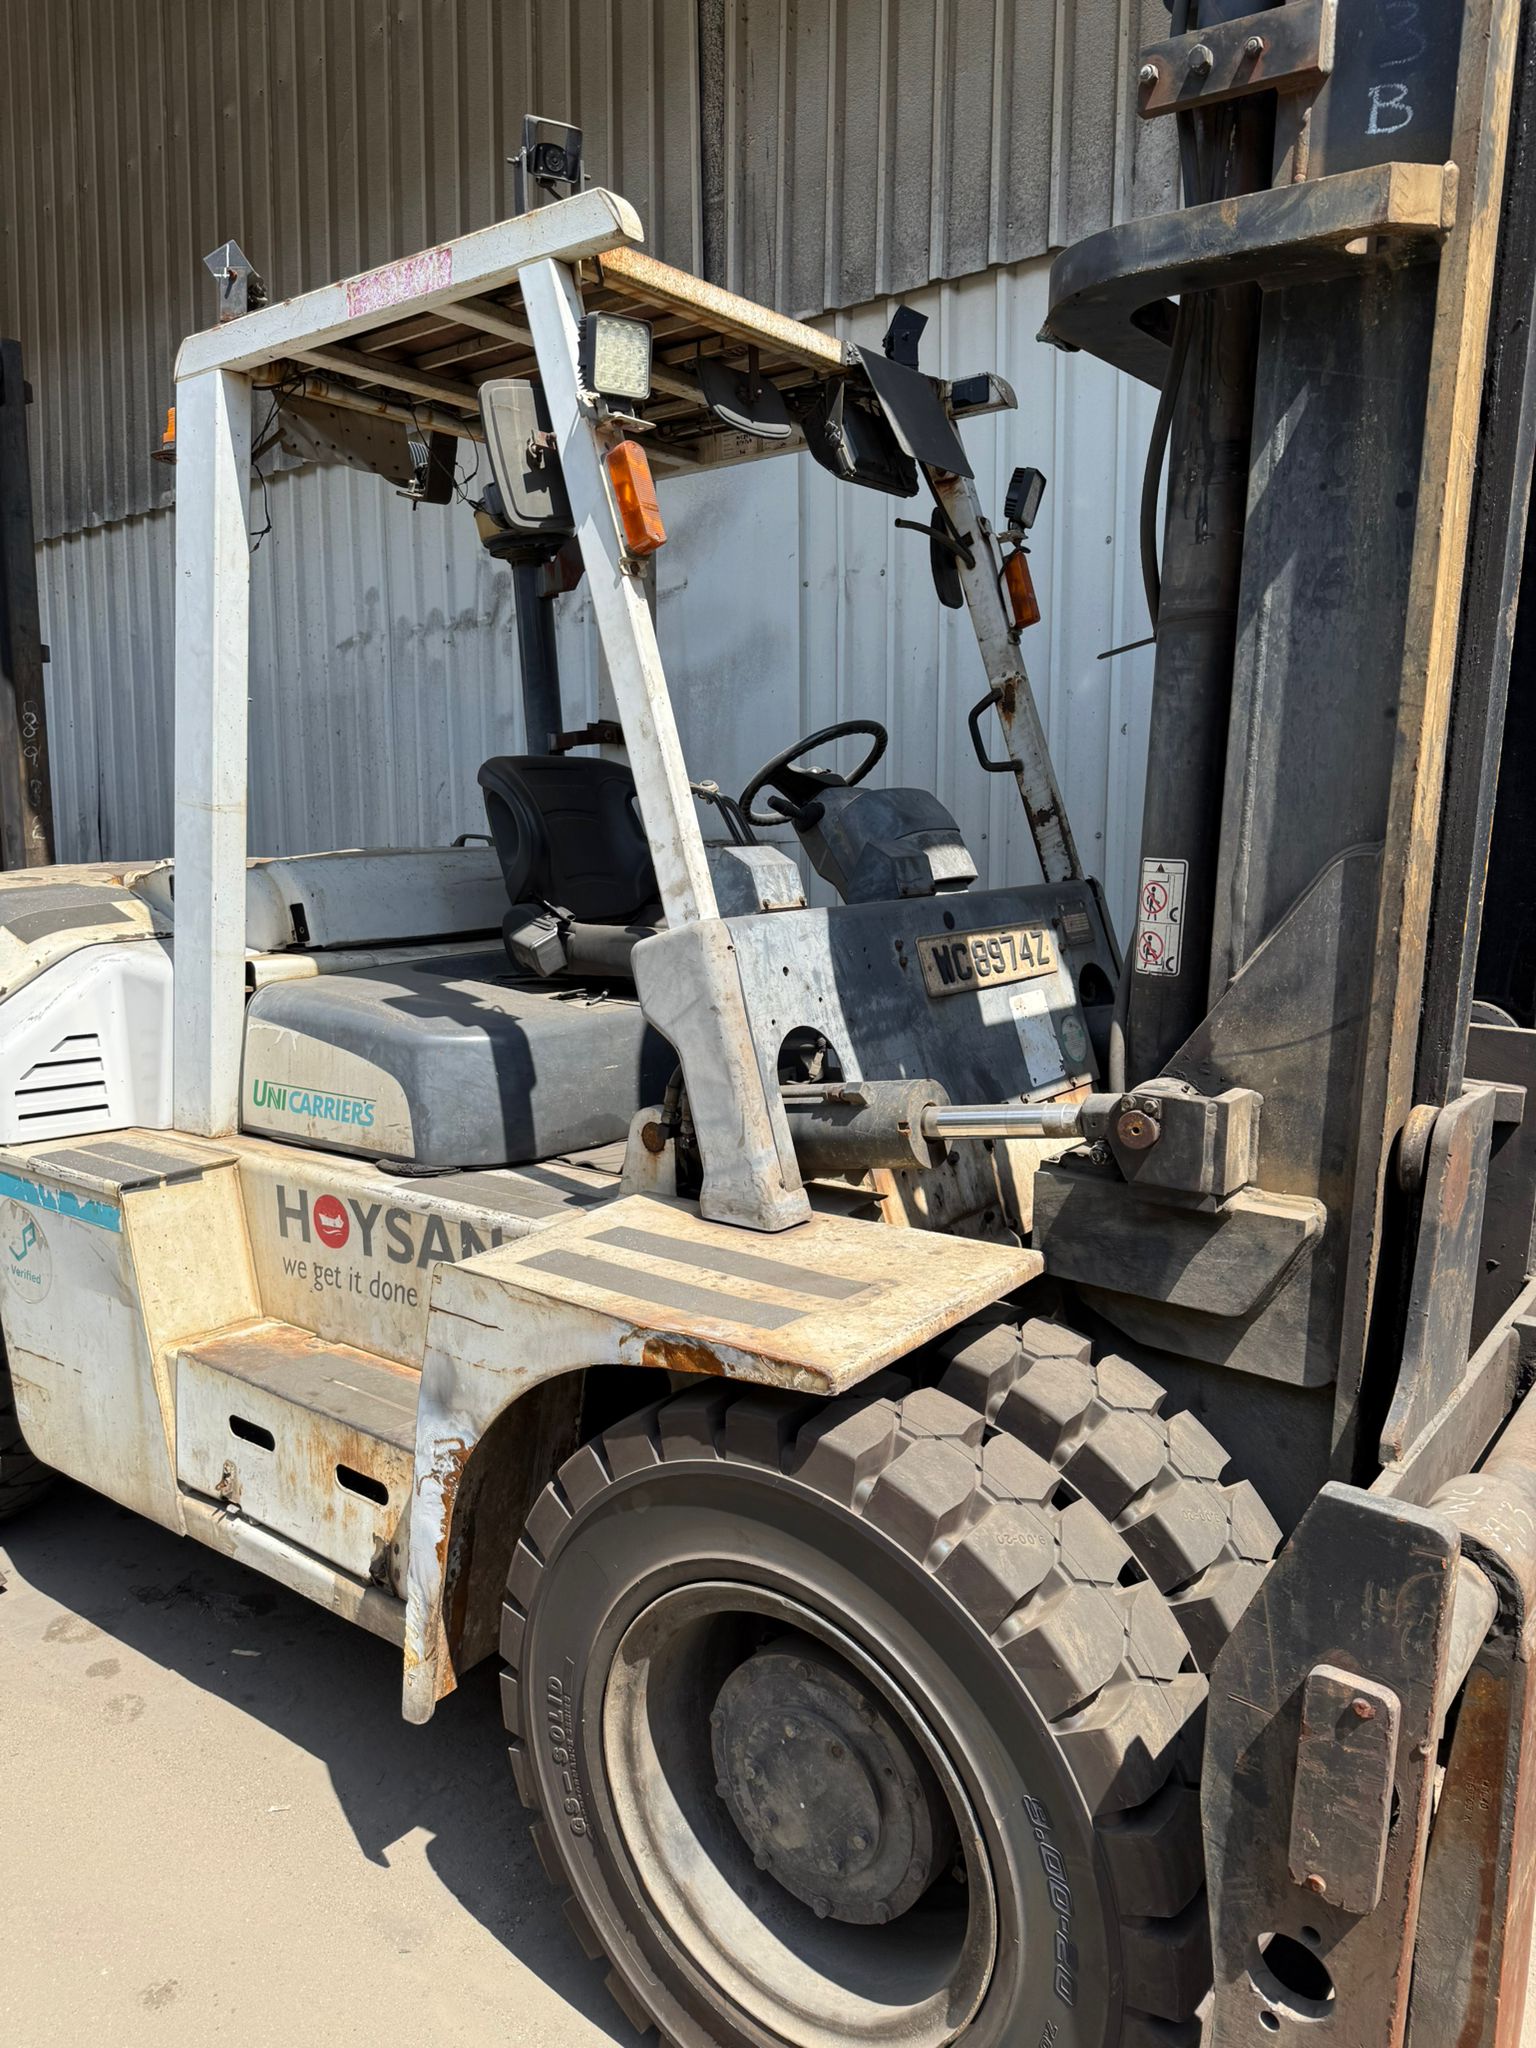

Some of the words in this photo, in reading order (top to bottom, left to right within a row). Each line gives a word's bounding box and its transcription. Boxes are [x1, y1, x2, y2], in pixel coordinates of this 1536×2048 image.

[1364, 82, 1414, 135] B
[931, 930, 1050, 985] WC8974Z
[253, 1079, 376, 1127] UNICARRIERS
[10, 1263, 42, 1286] Verified
[283, 1257, 308, 1279] we
[313, 1262, 342, 1292] get
[348, 1267, 363, 1295] it
[369, 1270, 418, 1308] done
[997, 1533, 1047, 1546] 9.00-20
[1022, 1793, 1078, 2008] 9.00-20
